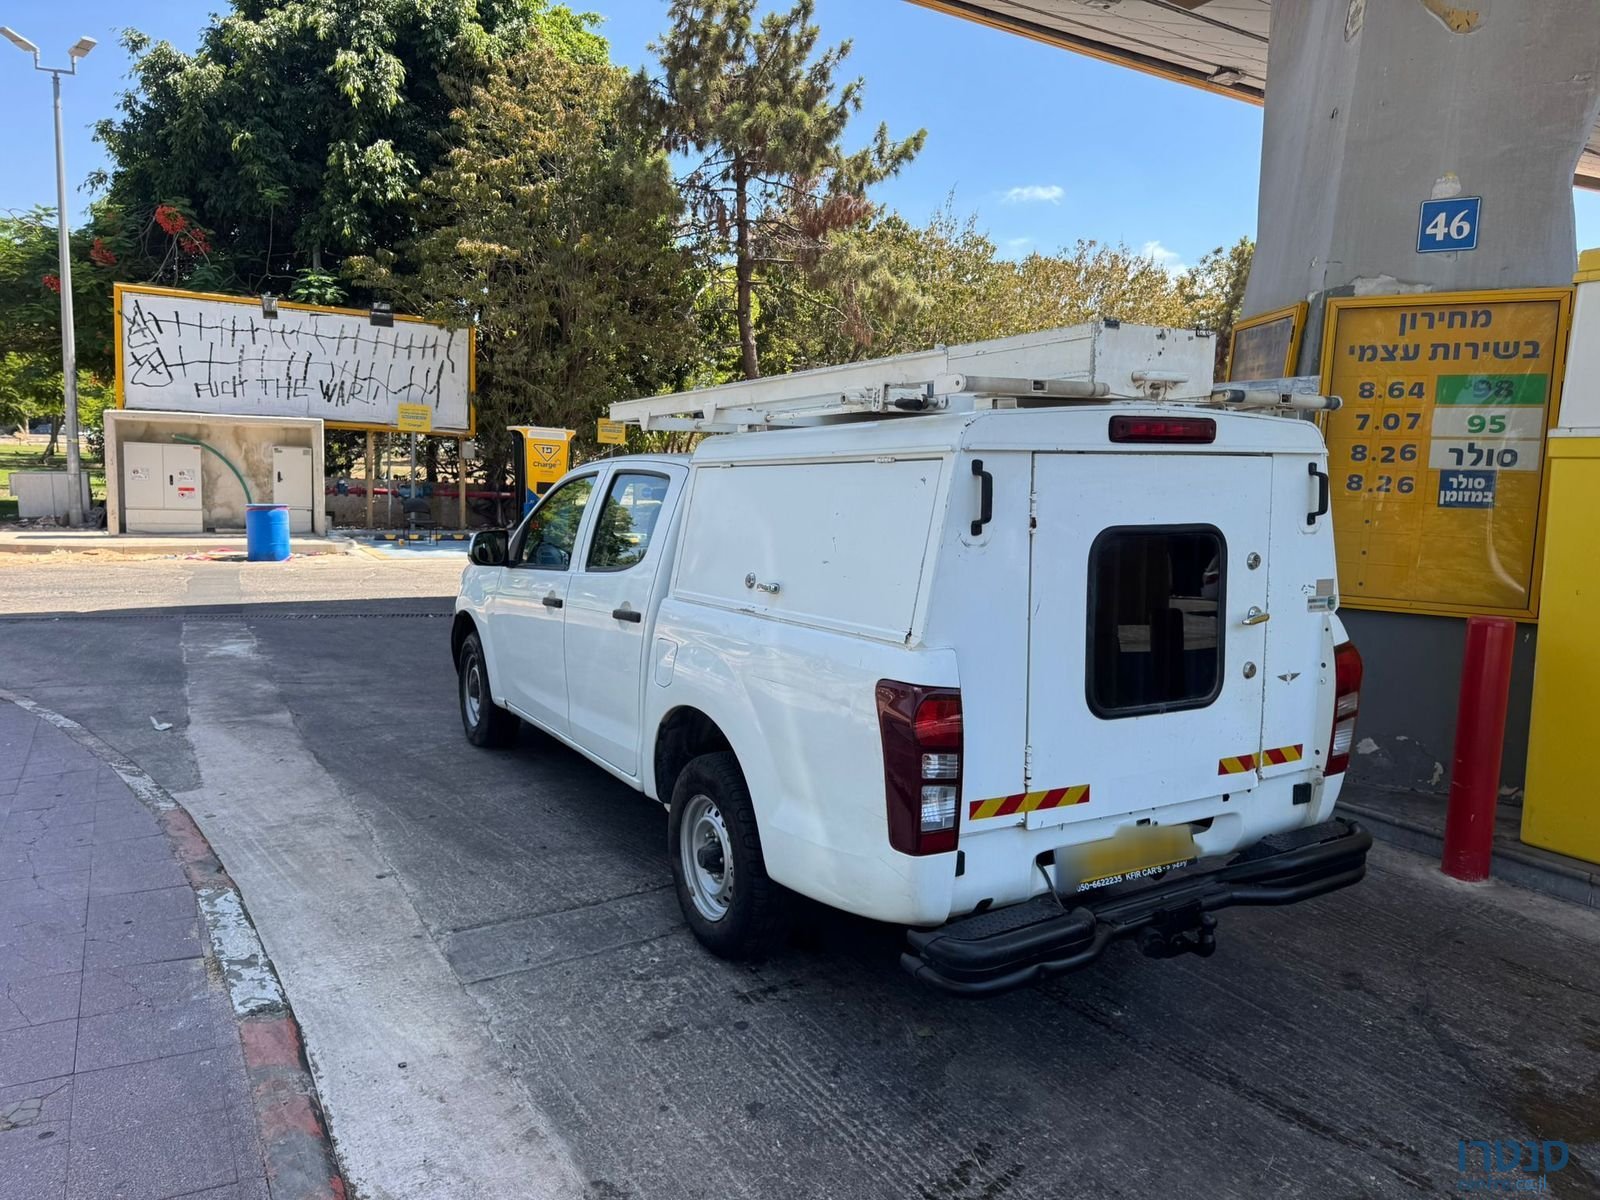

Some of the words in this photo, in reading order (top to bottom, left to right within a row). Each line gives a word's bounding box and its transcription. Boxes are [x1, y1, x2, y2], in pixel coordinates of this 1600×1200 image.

[1425, 209, 1471, 241] 46
[1398, 309, 1492, 336] מחירון
[1348, 344, 1420, 362] עצמי
[1428, 340, 1540, 361] בשירות
[256, 378, 314, 400] THE
[1358, 381, 1425, 399] 8.64
[1473, 379, 1514, 398] 98
[1355, 413, 1421, 431] 7.07
[1467, 415, 1506, 433] 95
[1350, 444, 1417, 463] 8.26
[1448, 442, 1518, 467] סולר
[532, 460, 556, 470] Charge
[1346, 474, 1414, 494] 8.26
[1449, 474, 1486, 489] סולר
[1439, 490, 1493, 505] במזומן
[1126, 870, 1142, 881] KFIR
